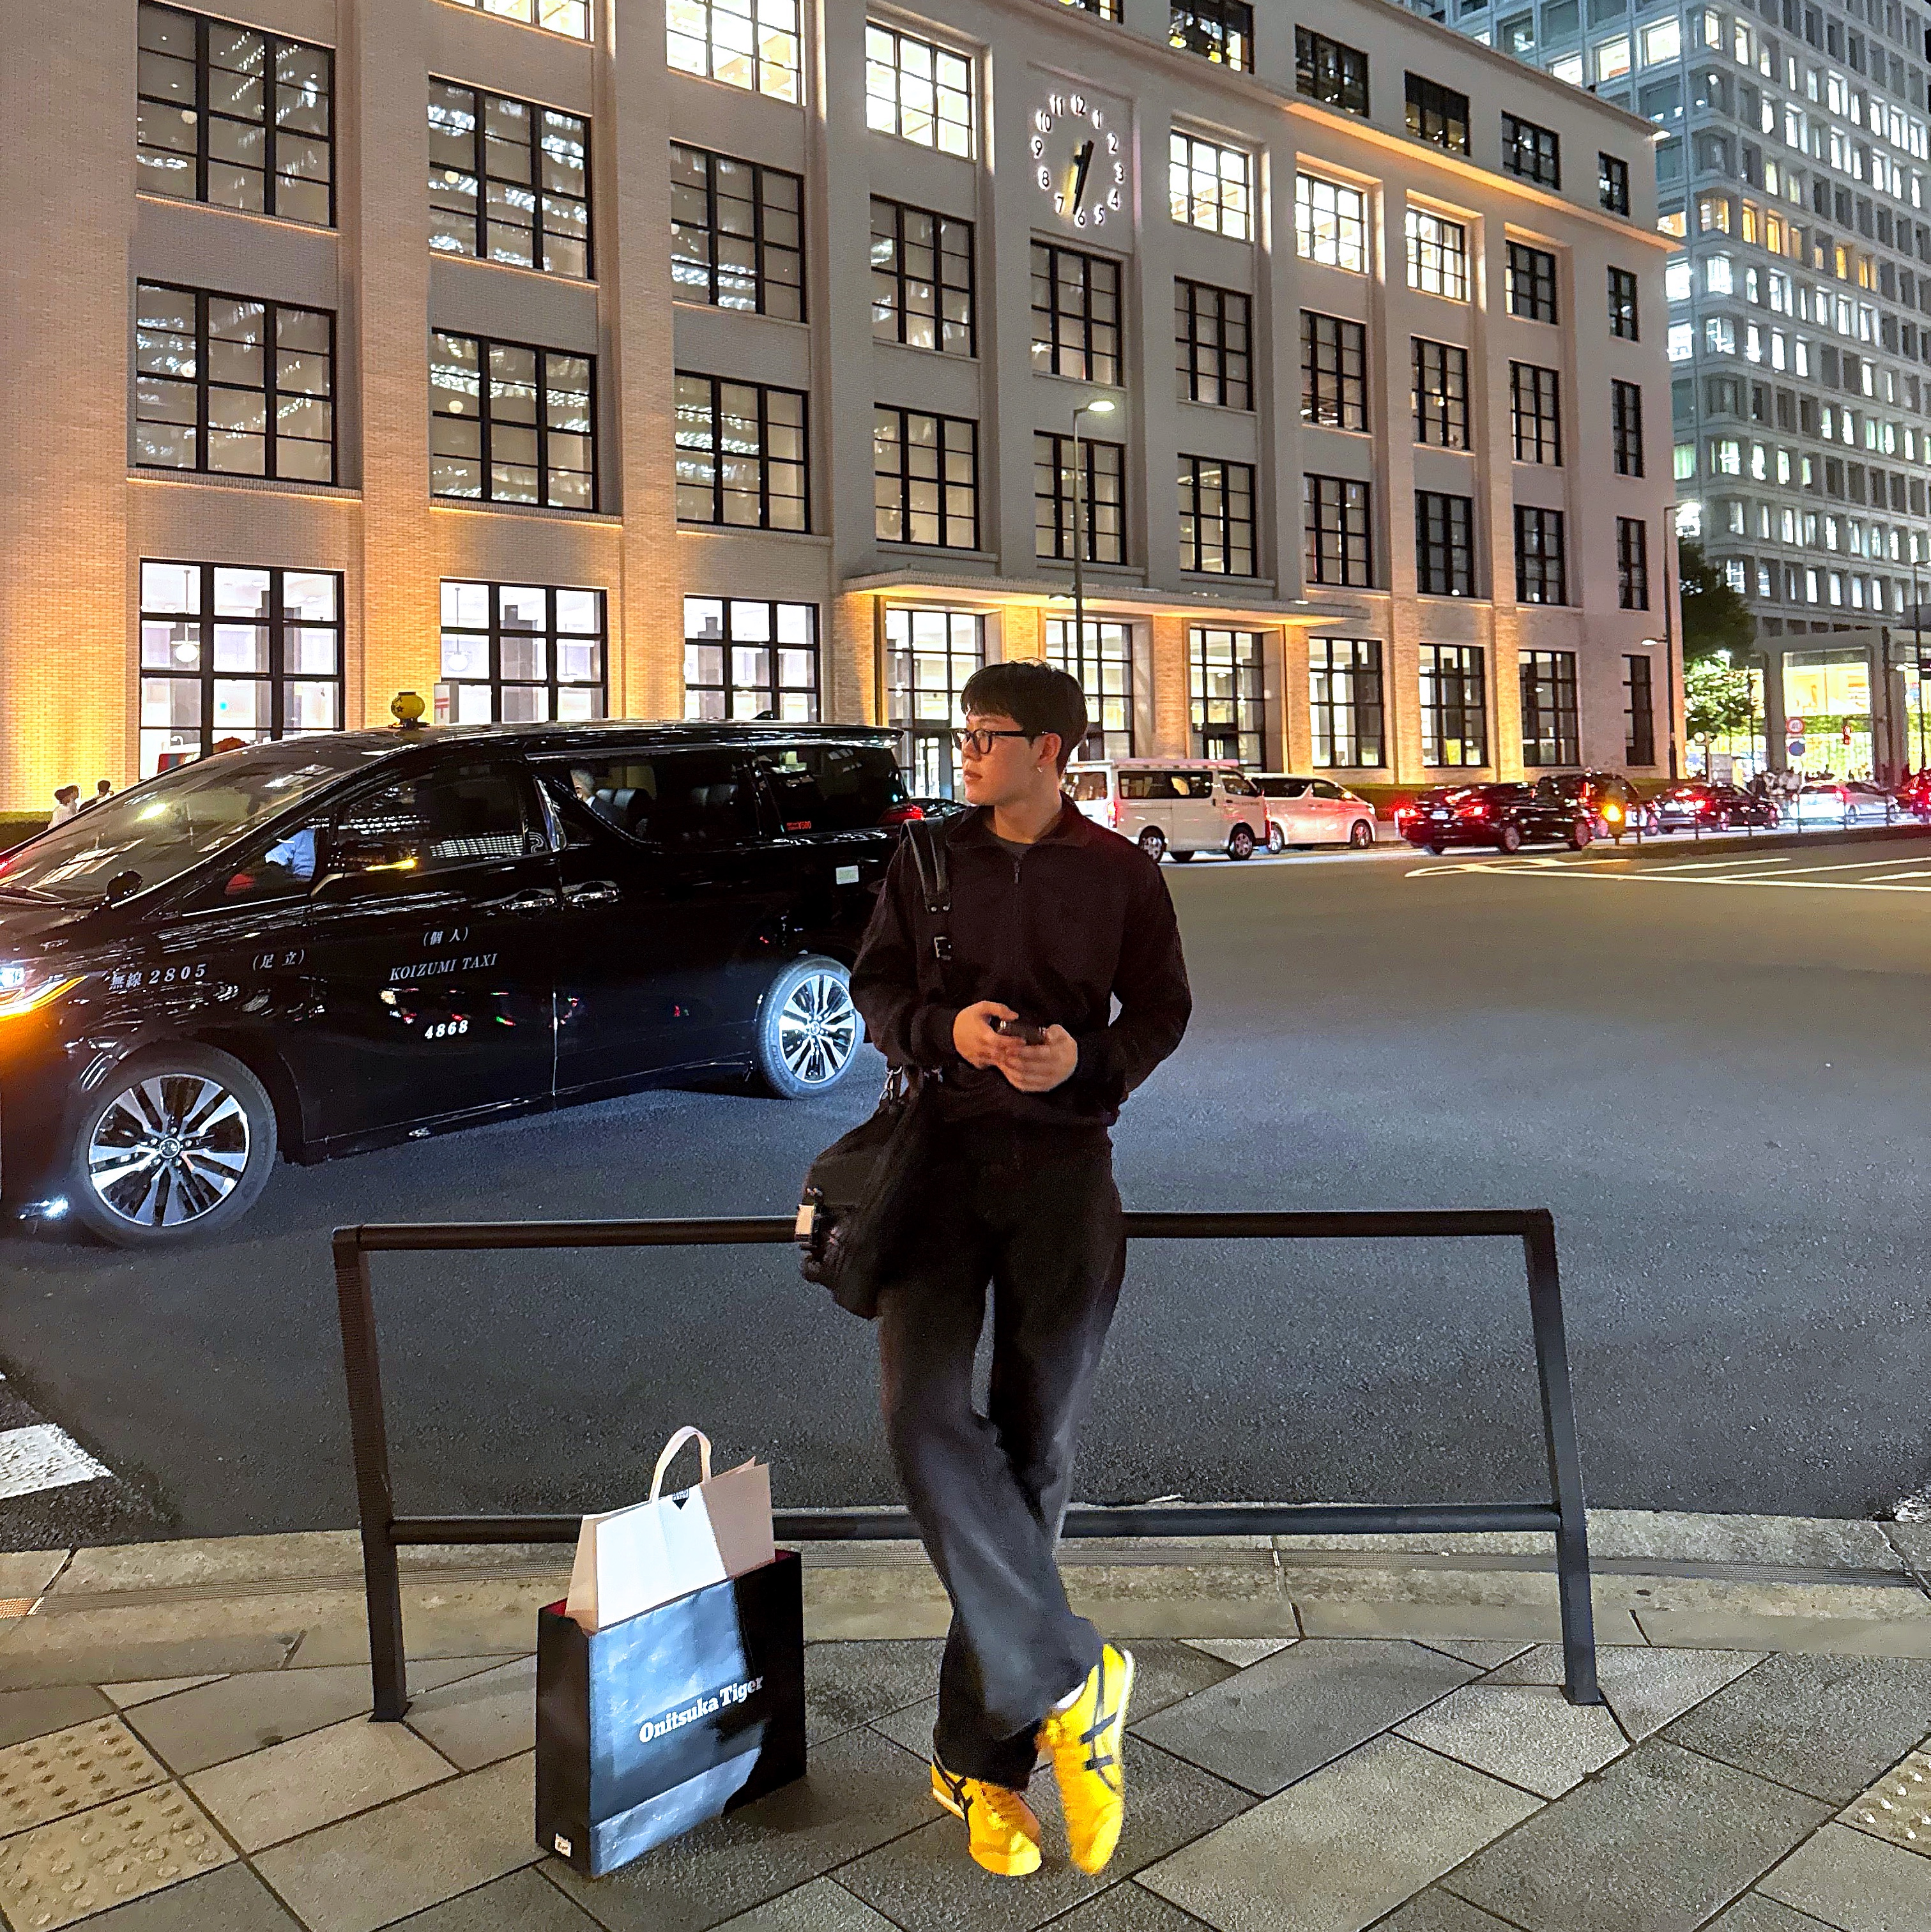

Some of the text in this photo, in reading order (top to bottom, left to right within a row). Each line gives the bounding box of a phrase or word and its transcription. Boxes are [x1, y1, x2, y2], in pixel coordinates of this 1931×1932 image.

[1049, 95, 1064, 116] 11
[1071, 95, 1085, 116] 12
[1035, 110, 1051, 132] 10
[1092, 109, 1102, 129] 1
[1031, 135, 1043, 158] 9
[1107, 133, 1118, 155] 2
[1038, 166, 1050, 190] 8
[1114, 162, 1124, 183] 3
[1055, 192, 1065, 213] 7
[1107, 188, 1120, 211] 4
[1074, 206, 1085, 228] 6
[1094, 204, 1104, 225] 5
[148, 963, 207, 985] 2805
[389, 953, 498, 981] KOIZUMI TAXI
[425, 1020, 468, 1039] 4868
[639, 1676, 763, 1743] Onitsuka Tiger
